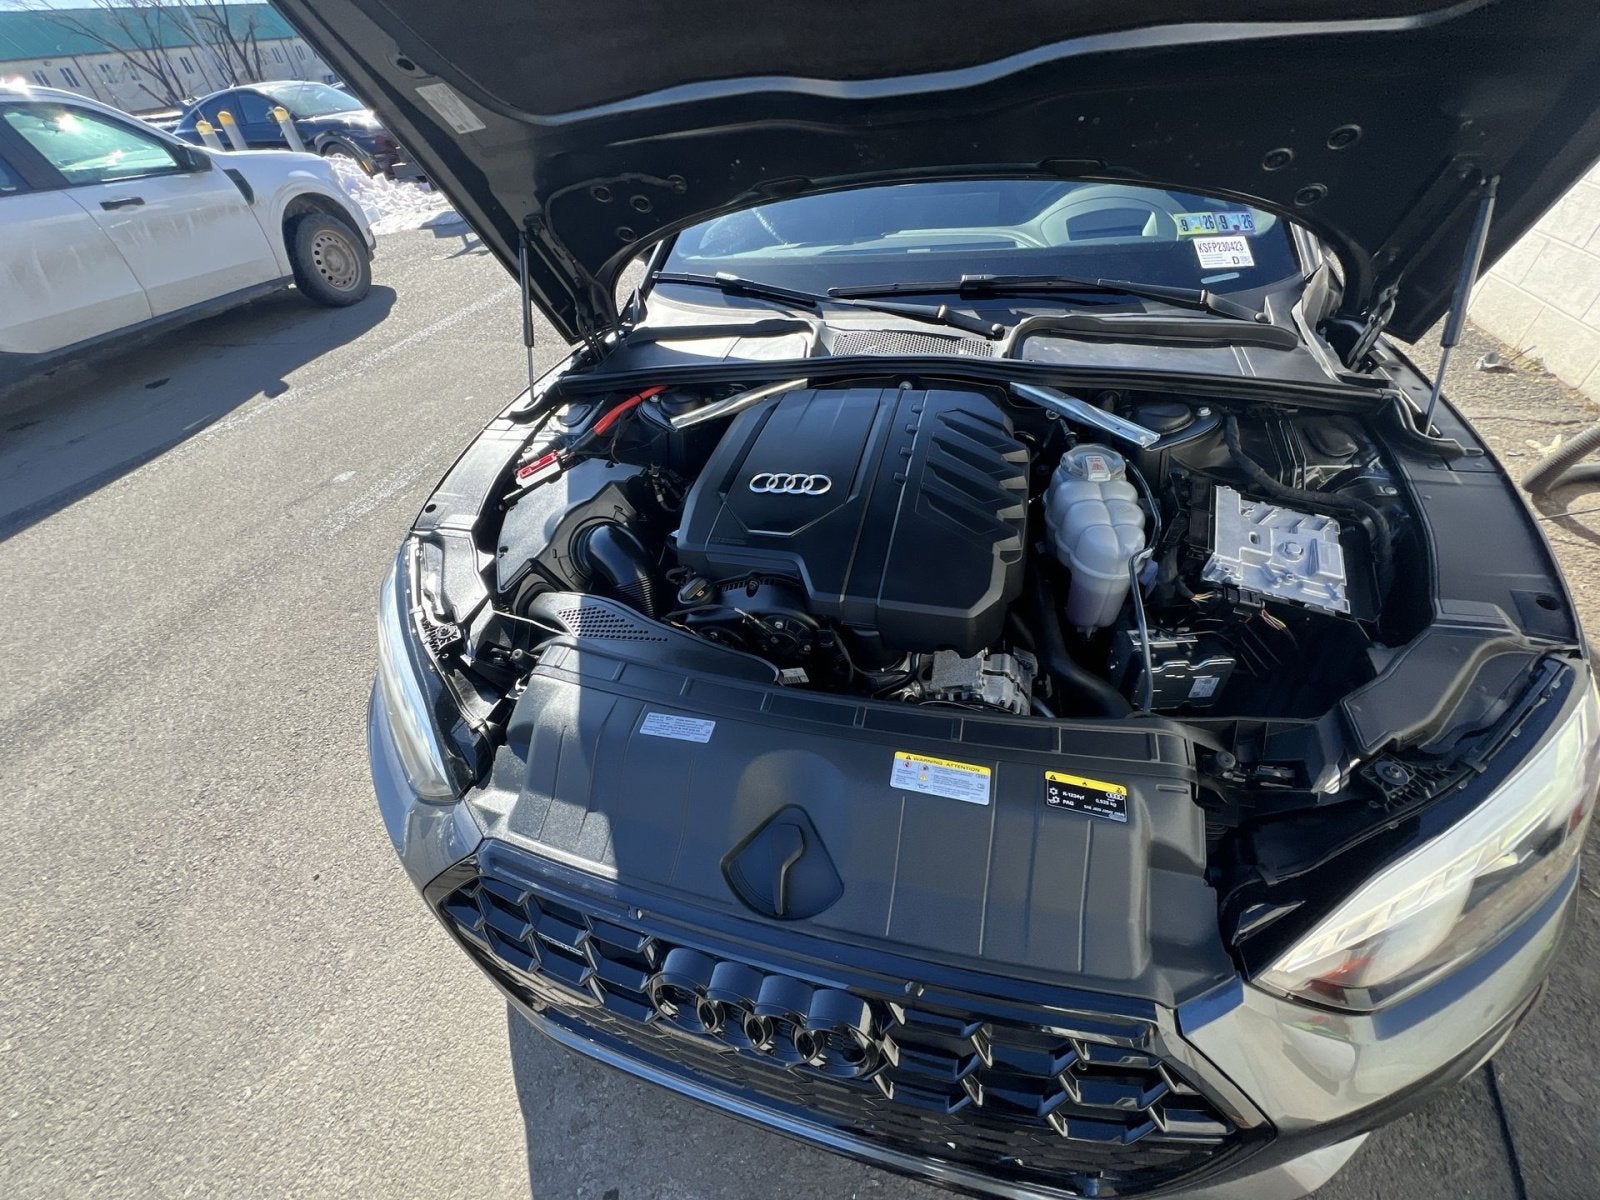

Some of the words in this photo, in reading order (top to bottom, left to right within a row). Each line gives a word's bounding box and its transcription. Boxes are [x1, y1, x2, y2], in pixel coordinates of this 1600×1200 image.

[1180, 219, 1189, 232] 9
[1219, 215, 1229, 230] 9
[1197, 241, 1244, 253] KSFP230423
[1232, 256, 1240, 265] D
